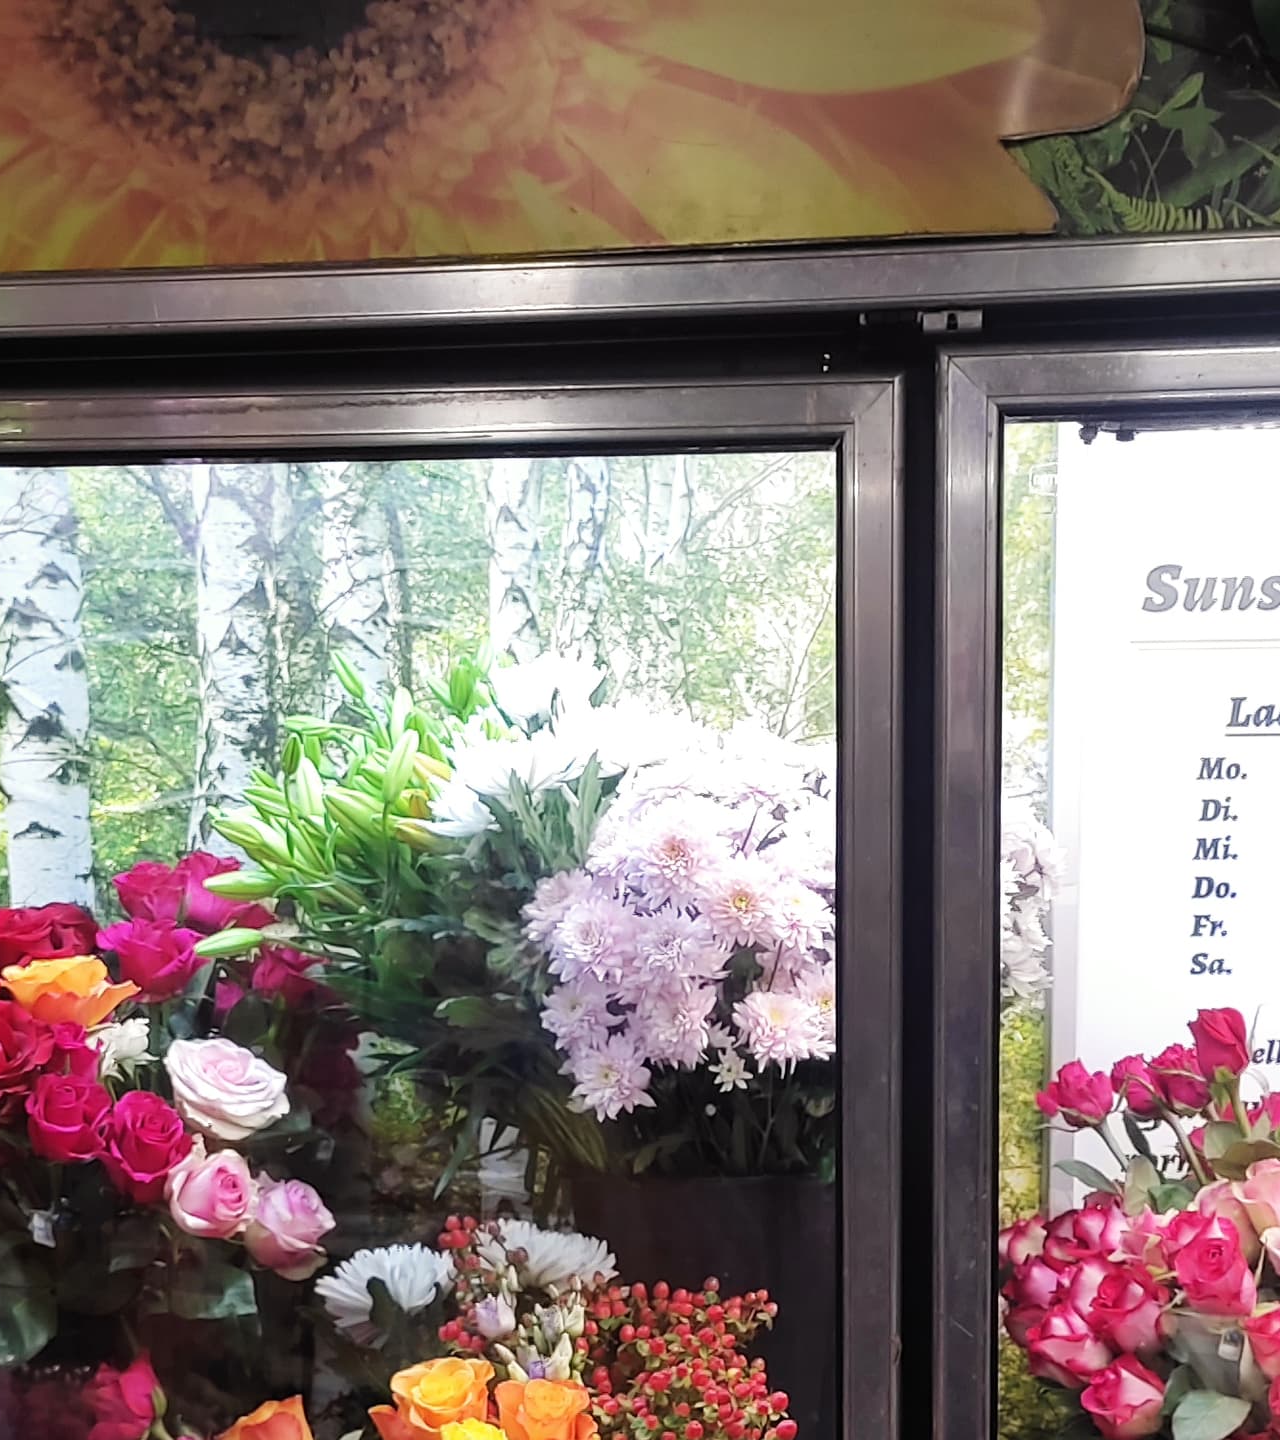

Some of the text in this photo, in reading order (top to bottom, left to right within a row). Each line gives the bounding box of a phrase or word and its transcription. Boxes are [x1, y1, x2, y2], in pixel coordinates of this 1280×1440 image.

[1195, 756, 1248, 781] Mo.
[1199, 797, 1239, 822] Di.
[1192, 835, 1239, 861] Mi.
[1191, 876, 1238, 900] Do.
[1190, 914, 1228, 938] Fr.
[1189, 952, 1233, 976] Sa.
